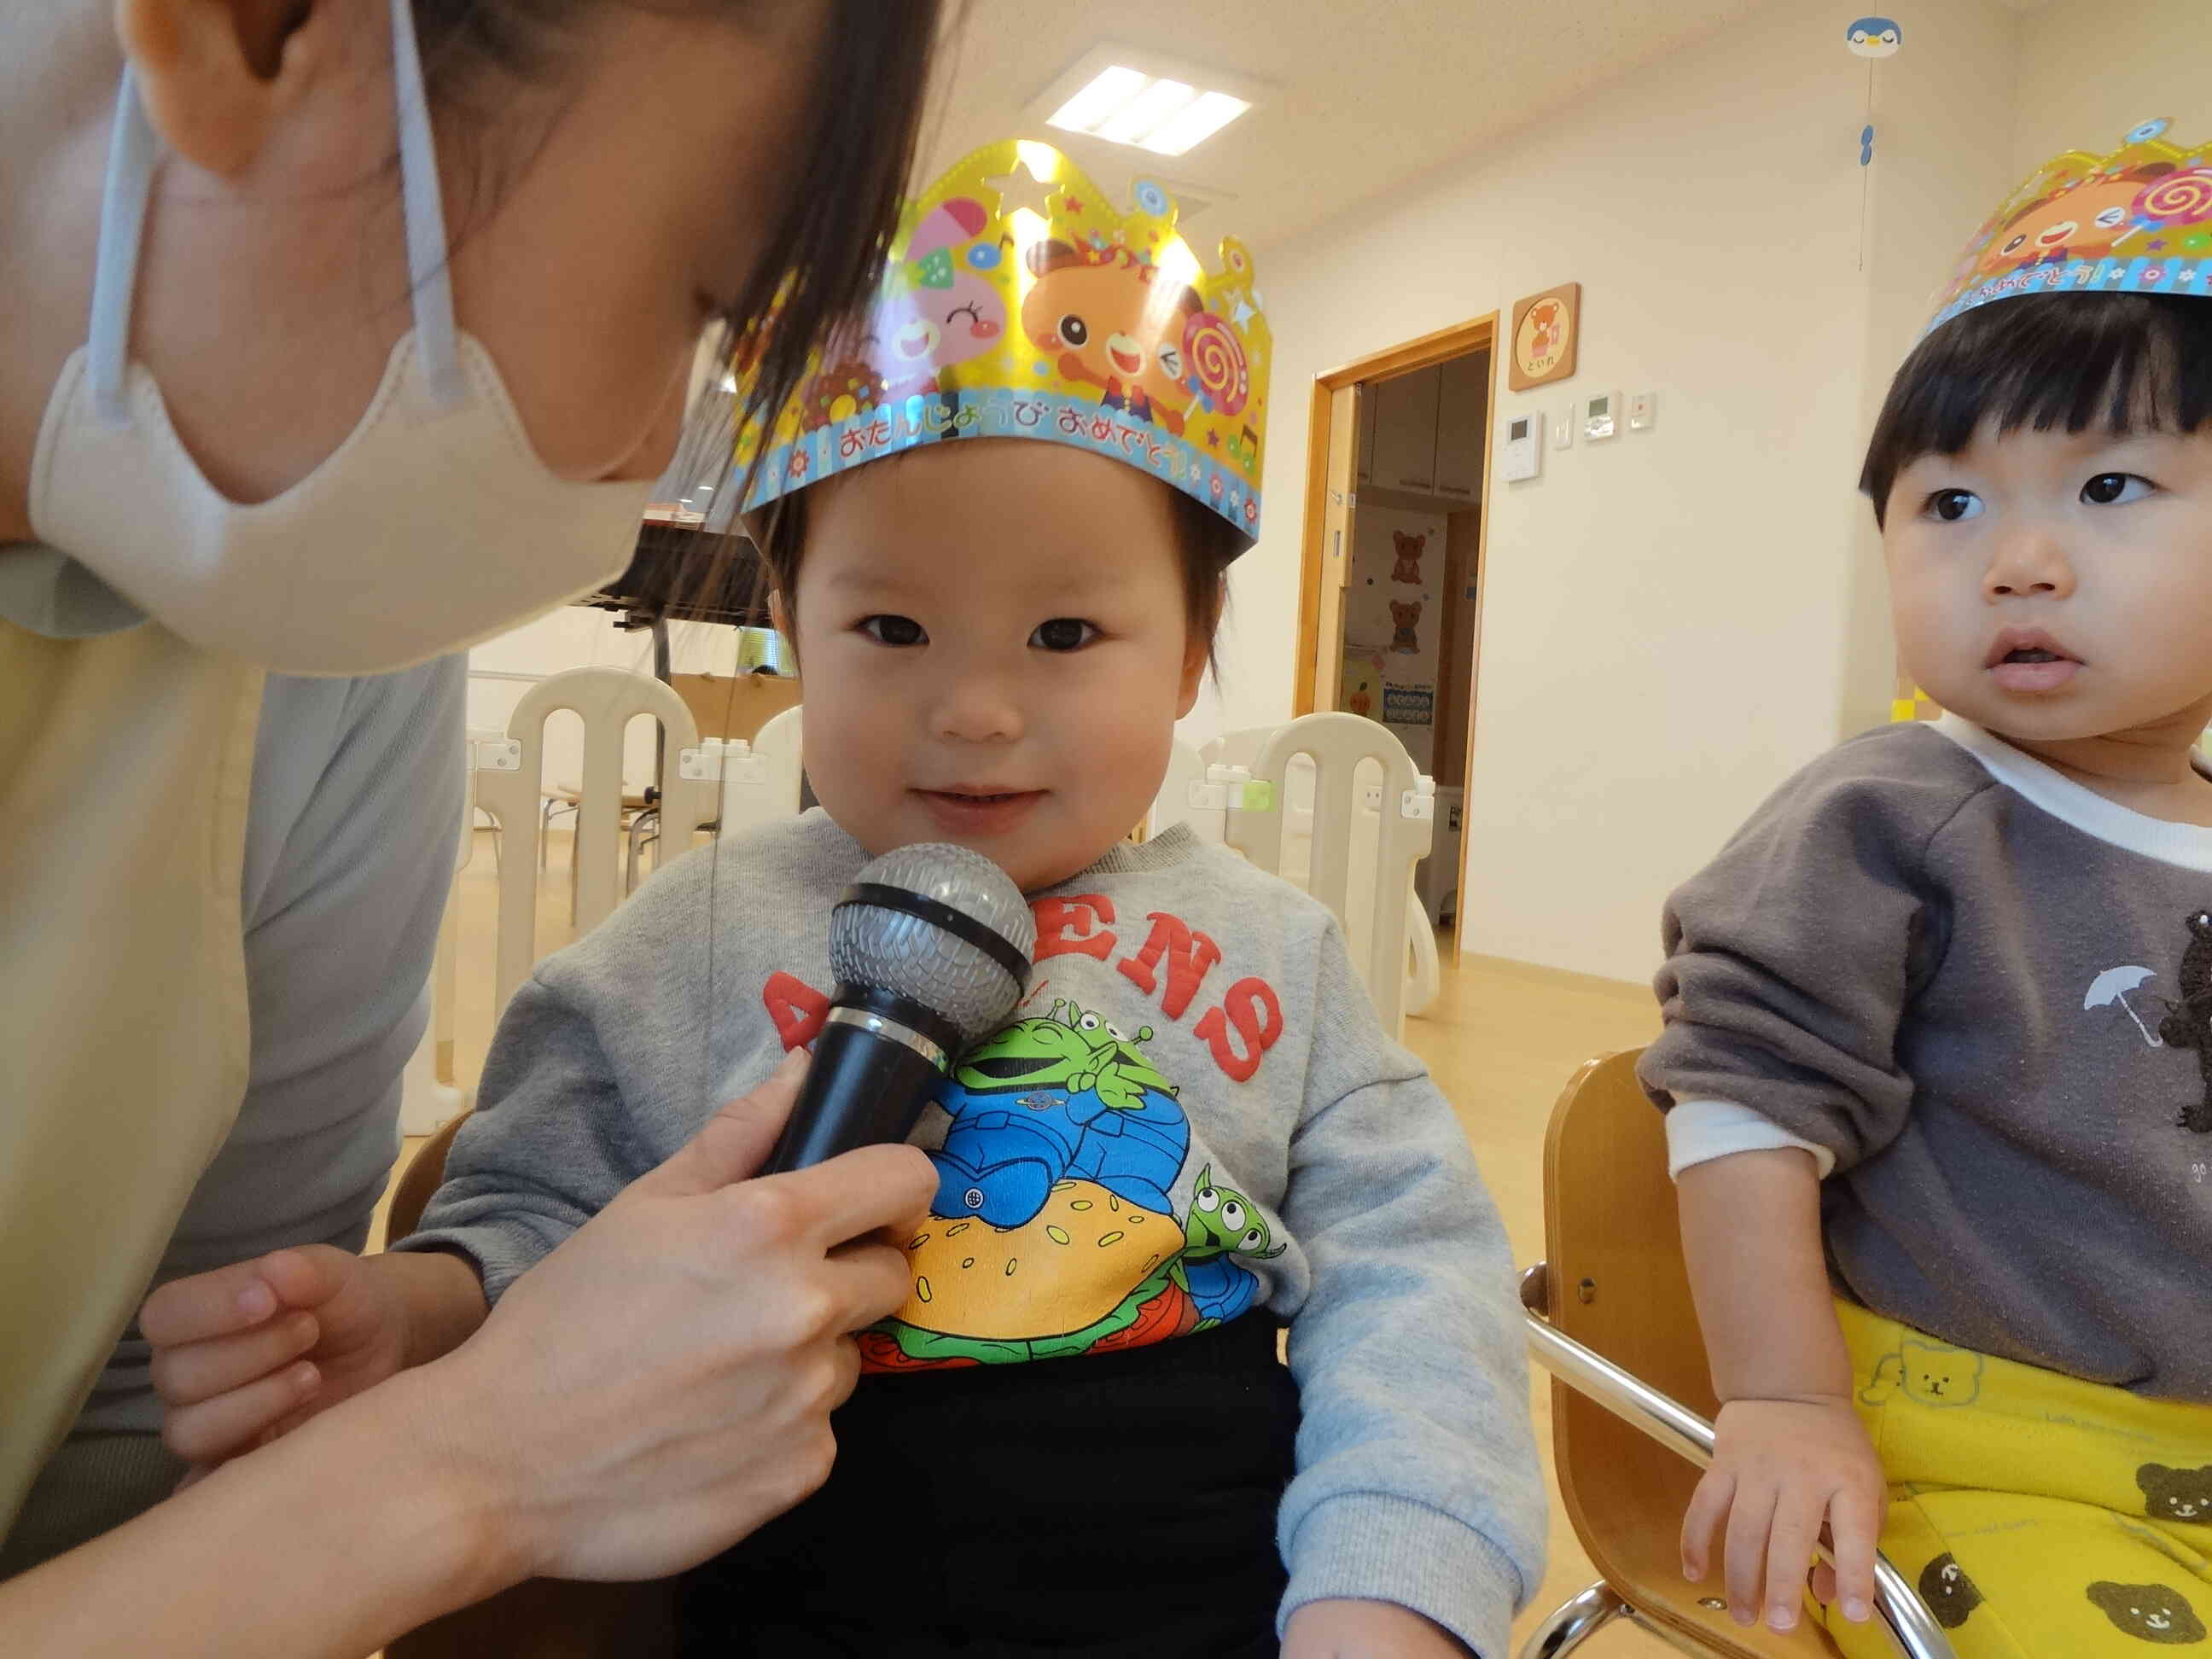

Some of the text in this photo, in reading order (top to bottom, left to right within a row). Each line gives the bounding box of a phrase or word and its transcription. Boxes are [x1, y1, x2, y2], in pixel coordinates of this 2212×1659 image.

[839, 399, 1187, 479] おたんじょうび おめでとう
[762, 893, 1284, 1082] AENS
